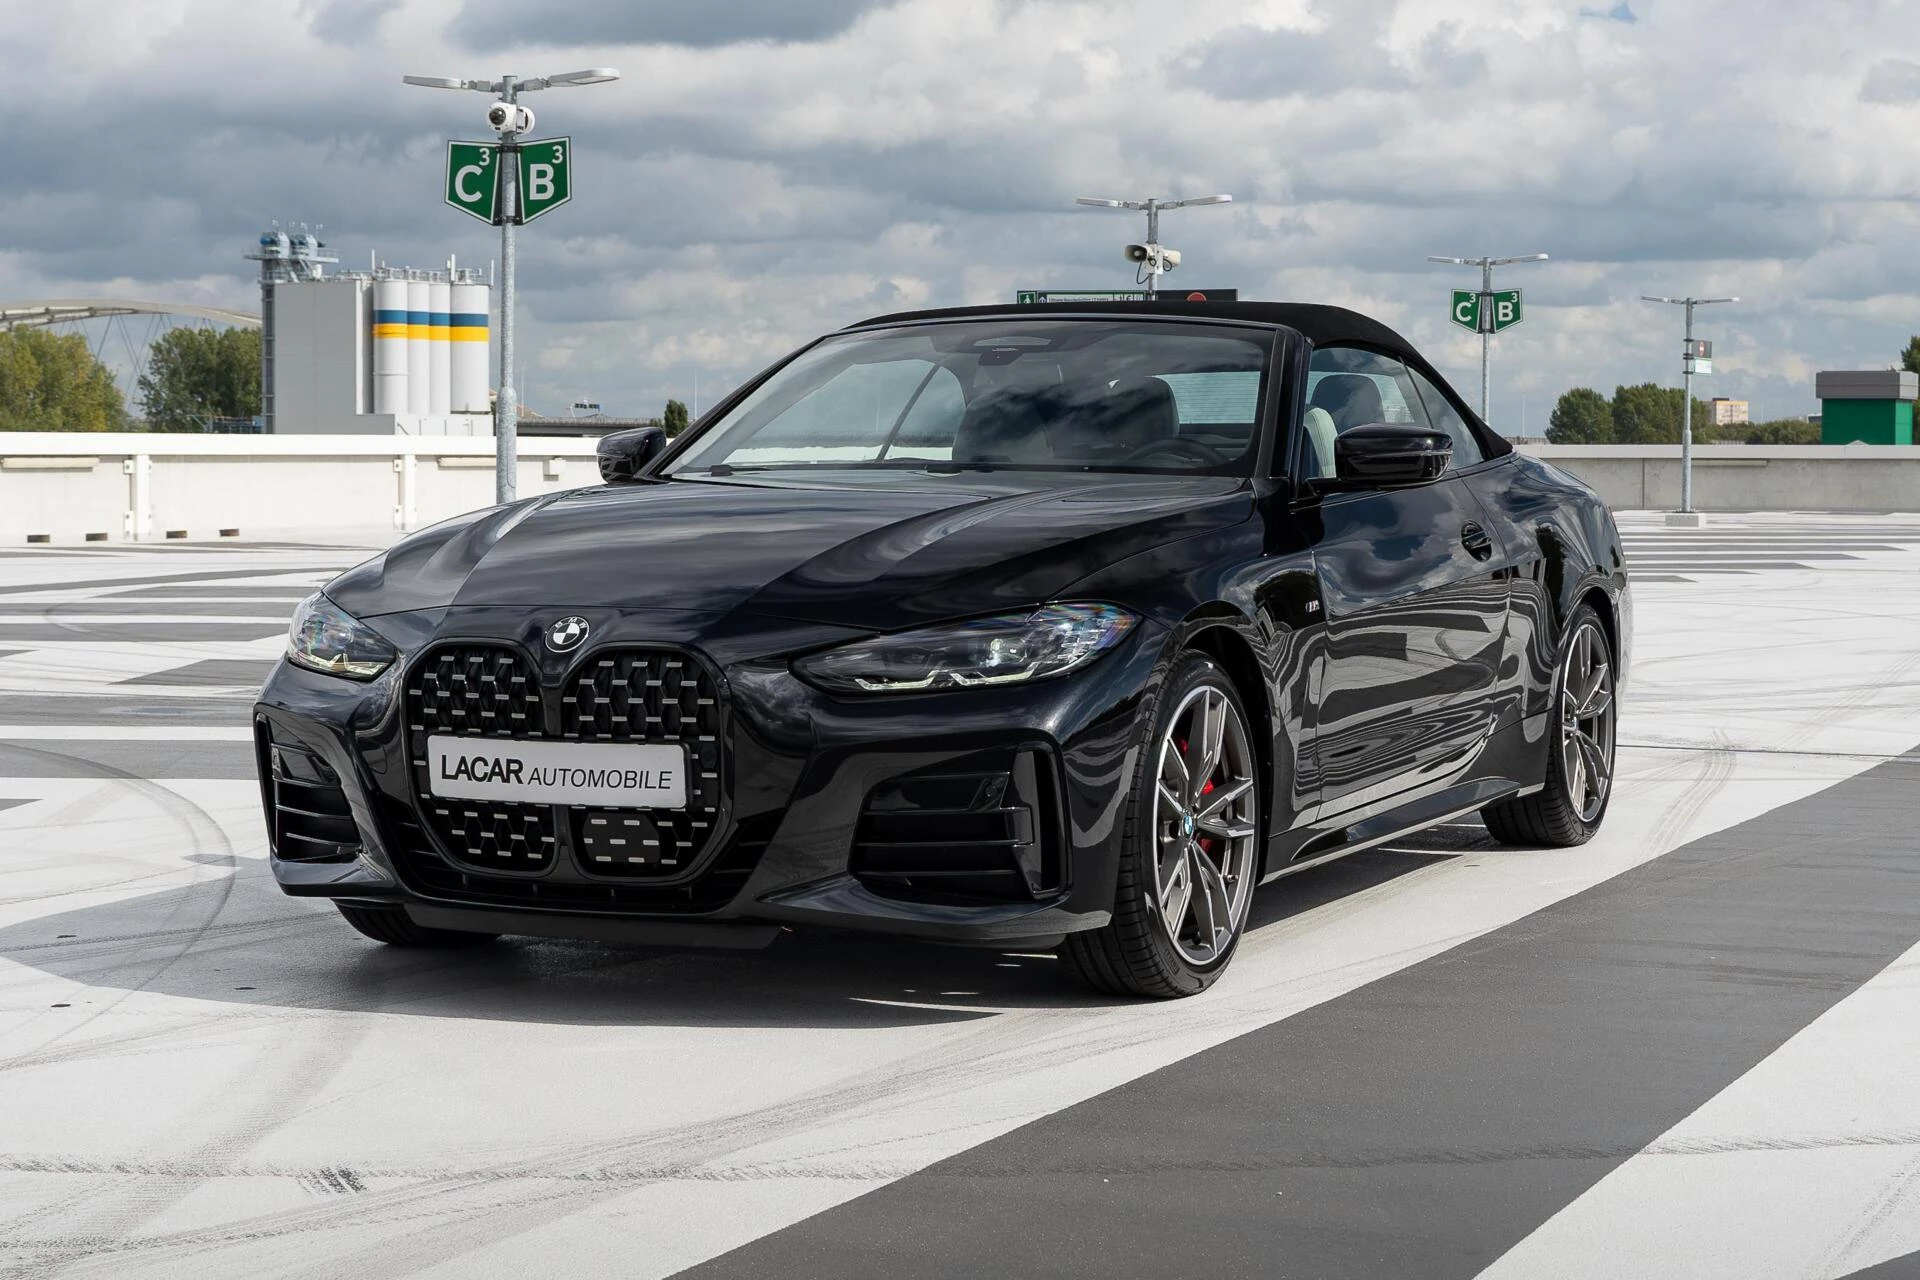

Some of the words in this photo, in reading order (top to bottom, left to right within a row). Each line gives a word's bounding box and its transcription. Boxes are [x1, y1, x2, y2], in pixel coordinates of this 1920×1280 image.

[455, 164, 482, 202] C
[479, 147, 490, 166] 3
[529, 163, 555, 200] B
[552, 145, 563, 163] 3
[1456, 301, 1472, 321] C
[1498, 301, 1513, 321] B
[554, 616, 587, 629] BMW
[441, 754, 524, 785] LACAR
[528, 767, 673, 790] AUTOMOBILE
